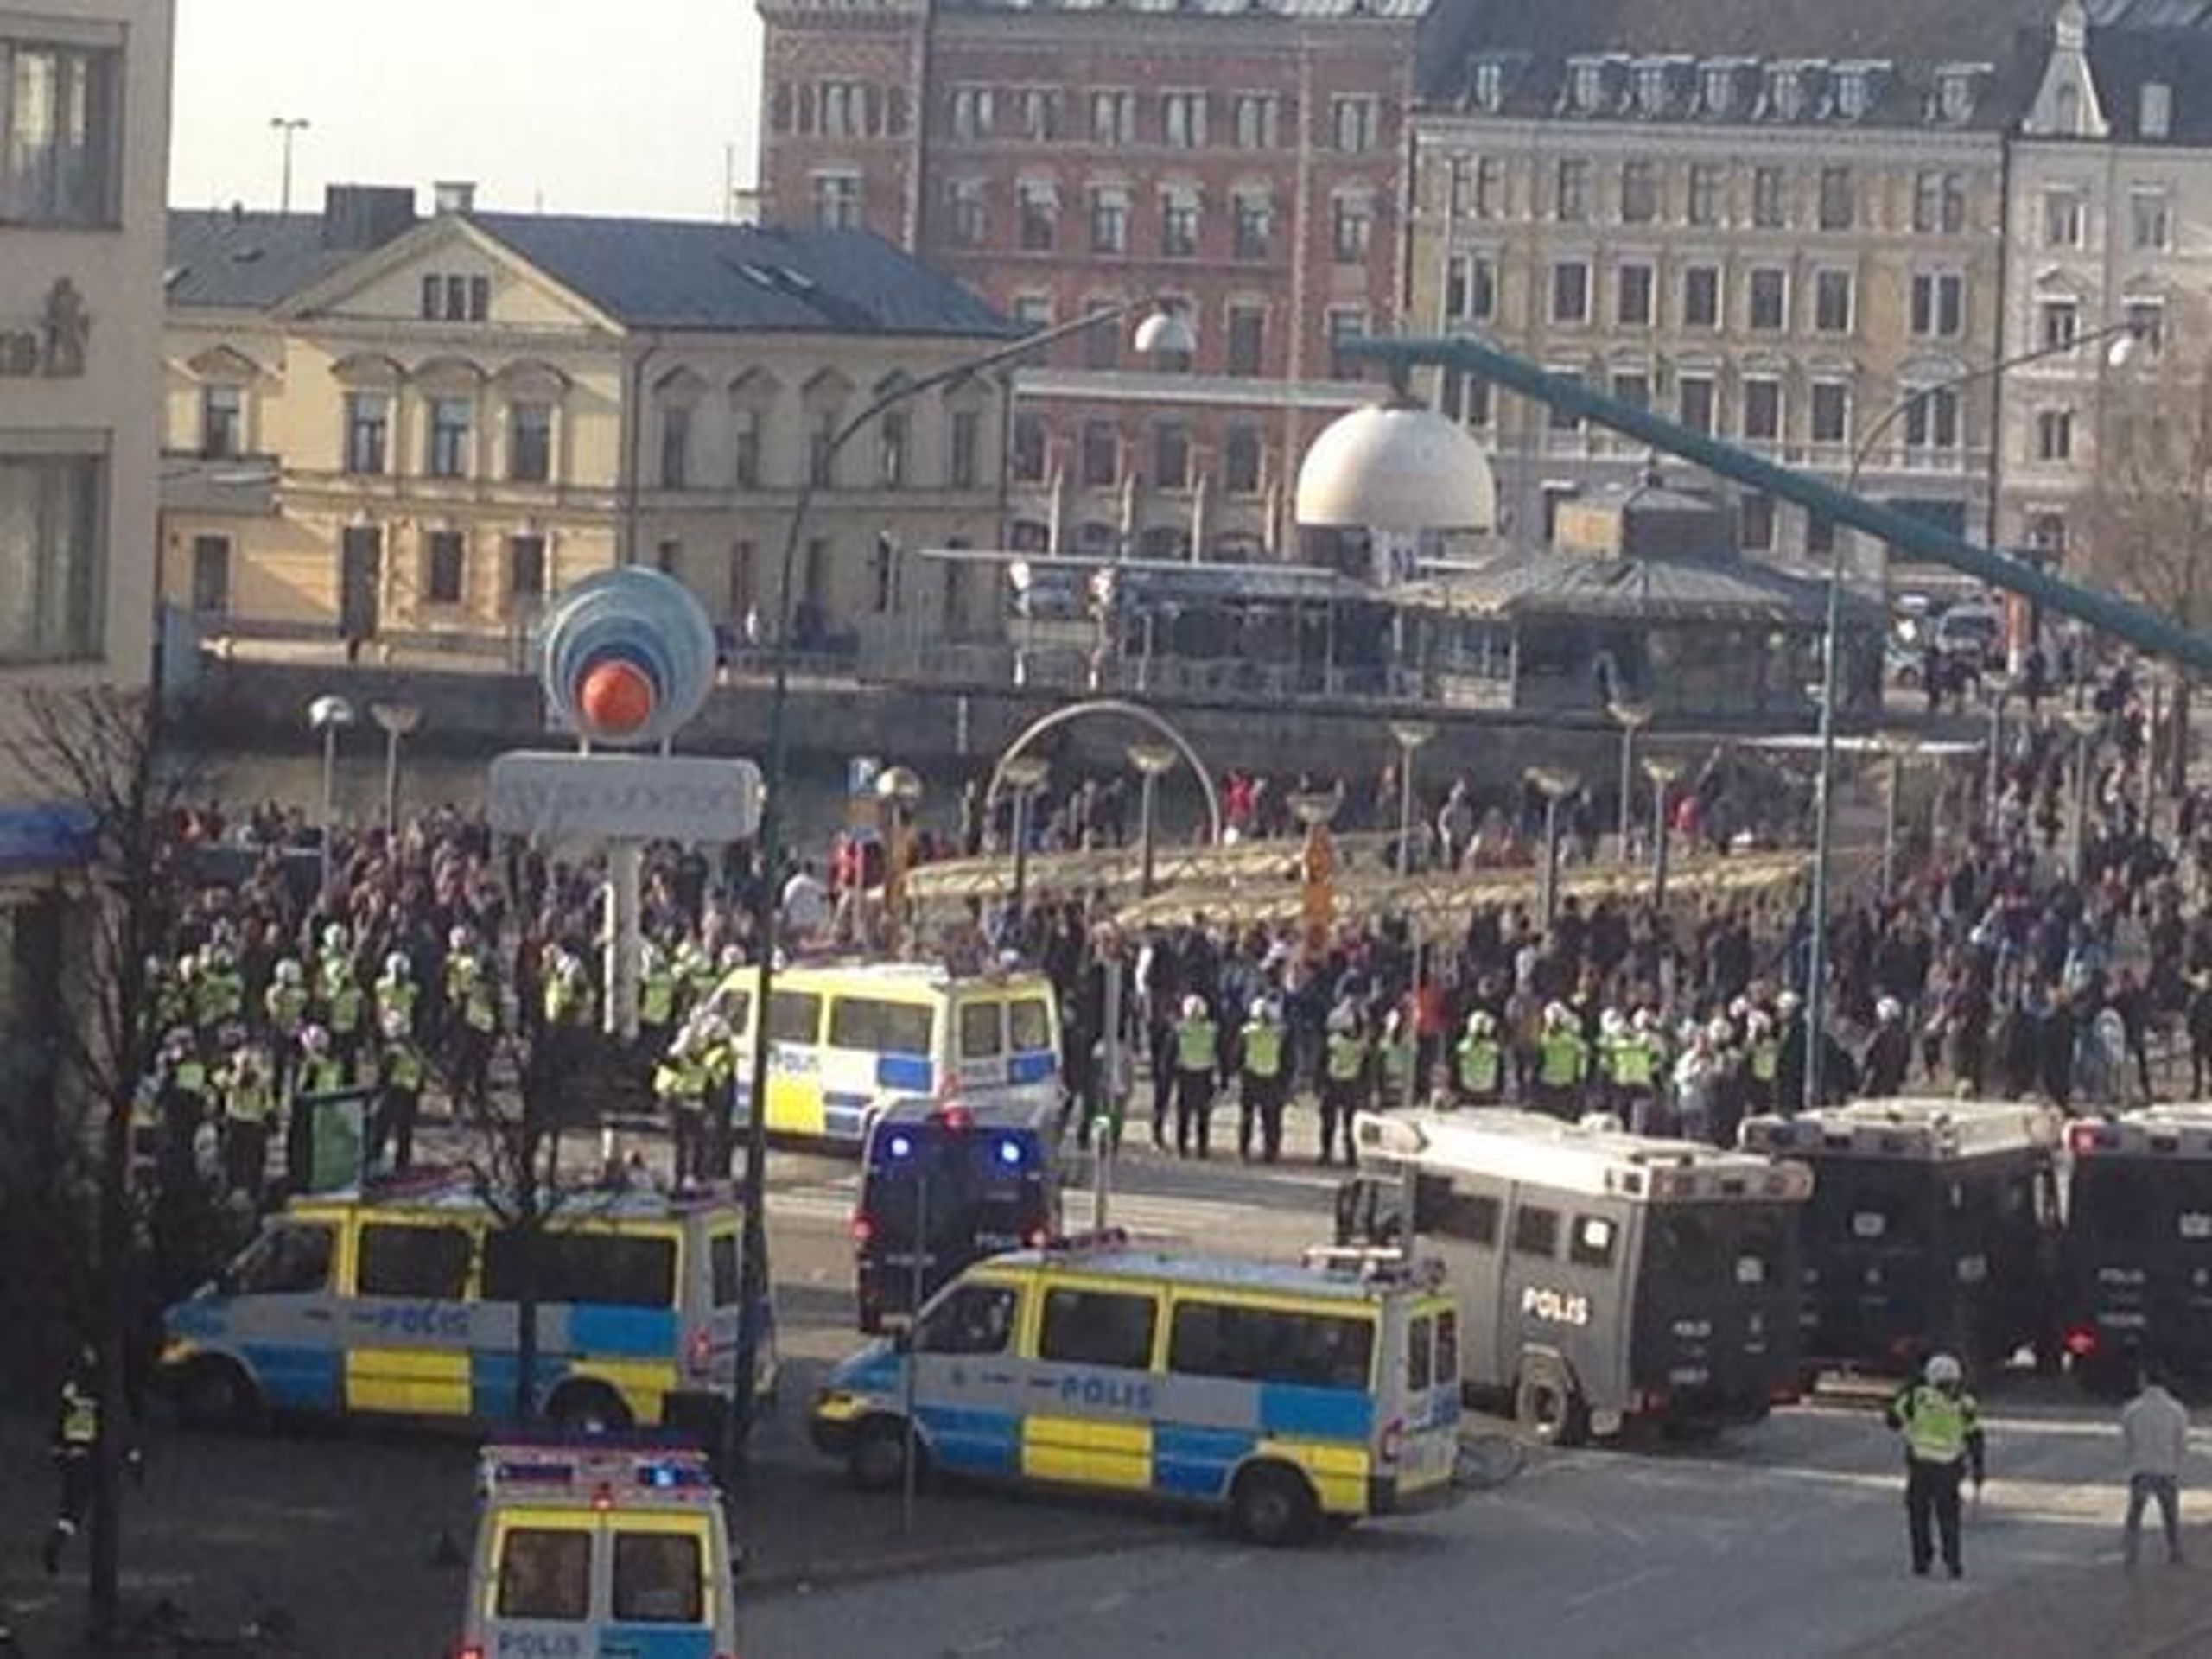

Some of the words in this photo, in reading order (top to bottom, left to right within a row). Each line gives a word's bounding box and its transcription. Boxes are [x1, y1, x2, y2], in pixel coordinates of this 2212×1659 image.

[378, 1303, 471, 1336] POLIS
[1522, 1287, 1588, 1325] POLIS
[1061, 1375, 1154, 1411] POLIS
[496, 1630, 581, 1657] POLIS
